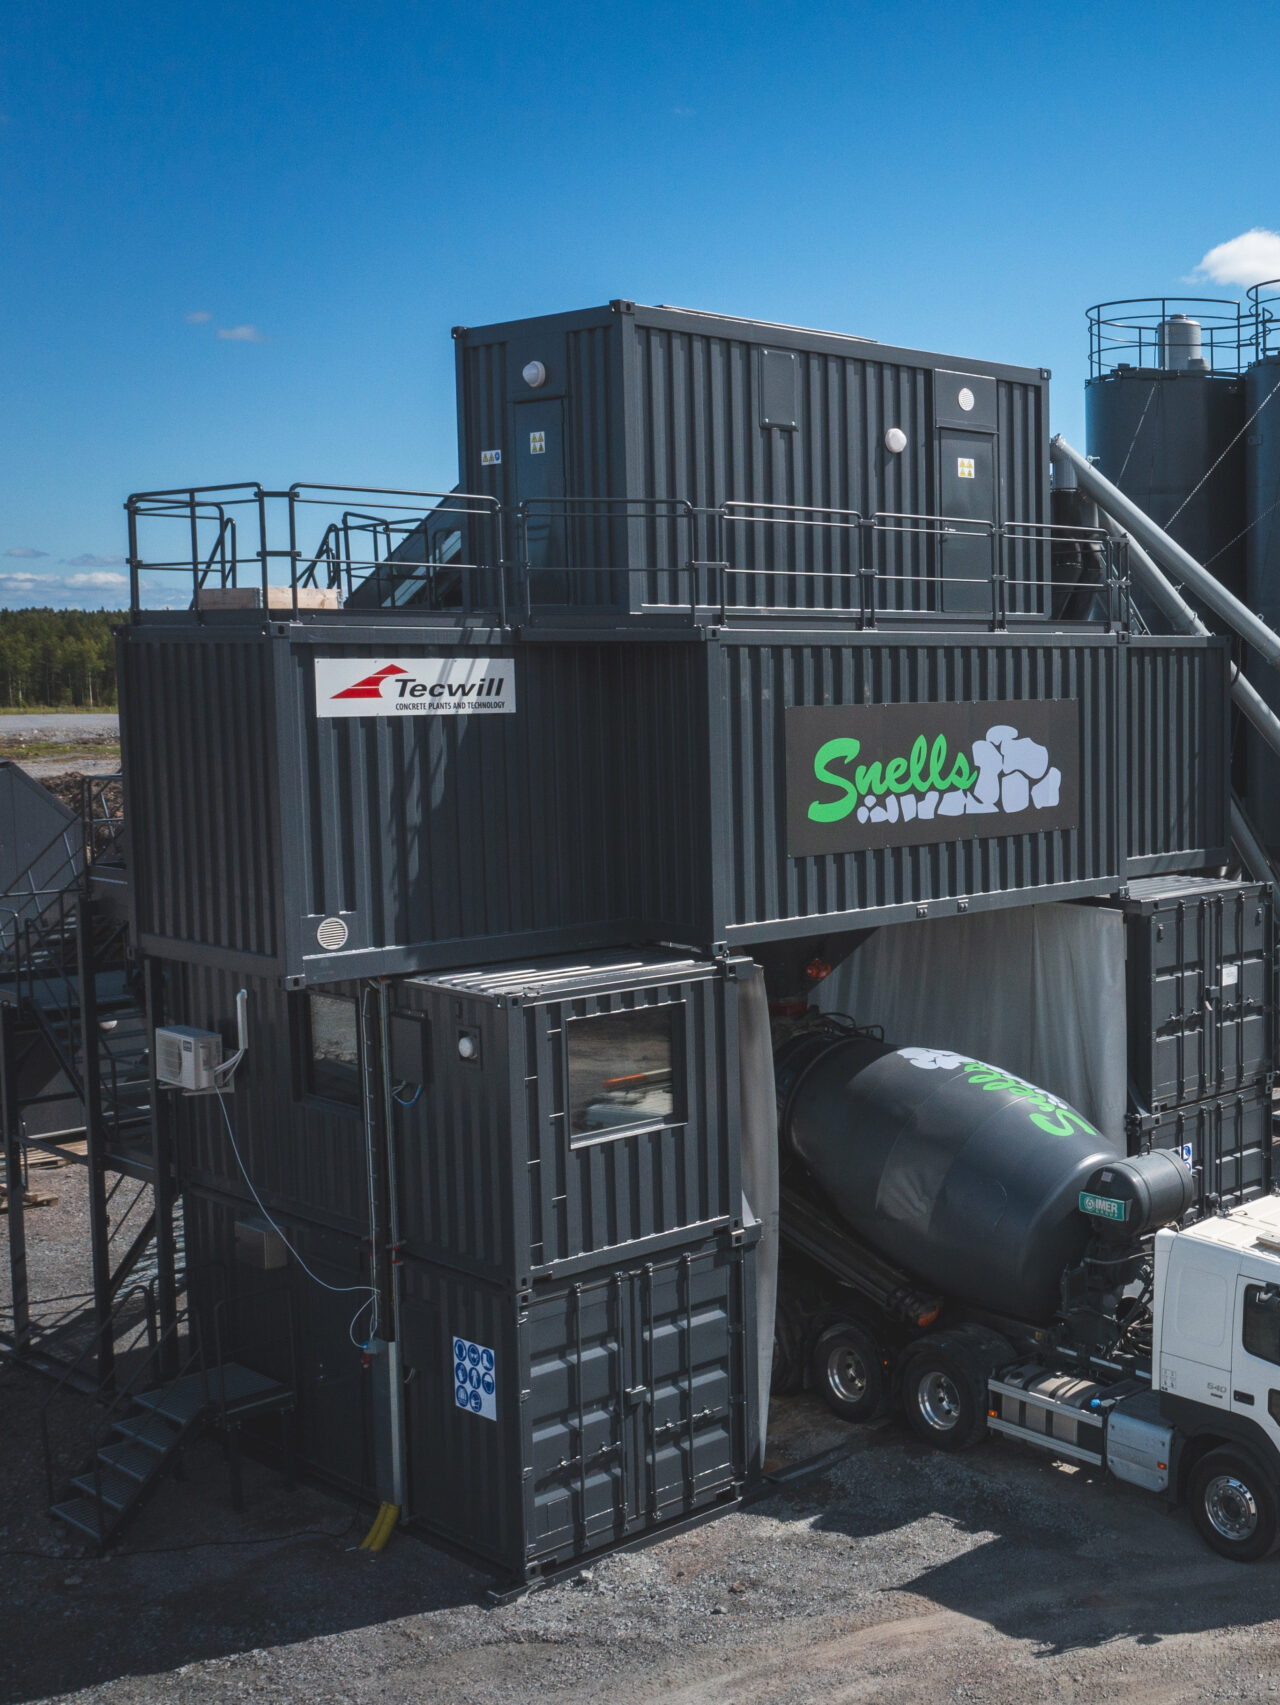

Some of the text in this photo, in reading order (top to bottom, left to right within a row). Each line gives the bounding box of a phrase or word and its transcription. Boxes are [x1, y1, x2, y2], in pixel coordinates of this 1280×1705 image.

[395, 677, 505, 698] Tecwill
[395, 701, 506, 711] CONCRETE PLANTS AND TECHNOLOGY
[807, 733, 978, 823] Snells
[1095, 1198, 1118, 1214] IMER
